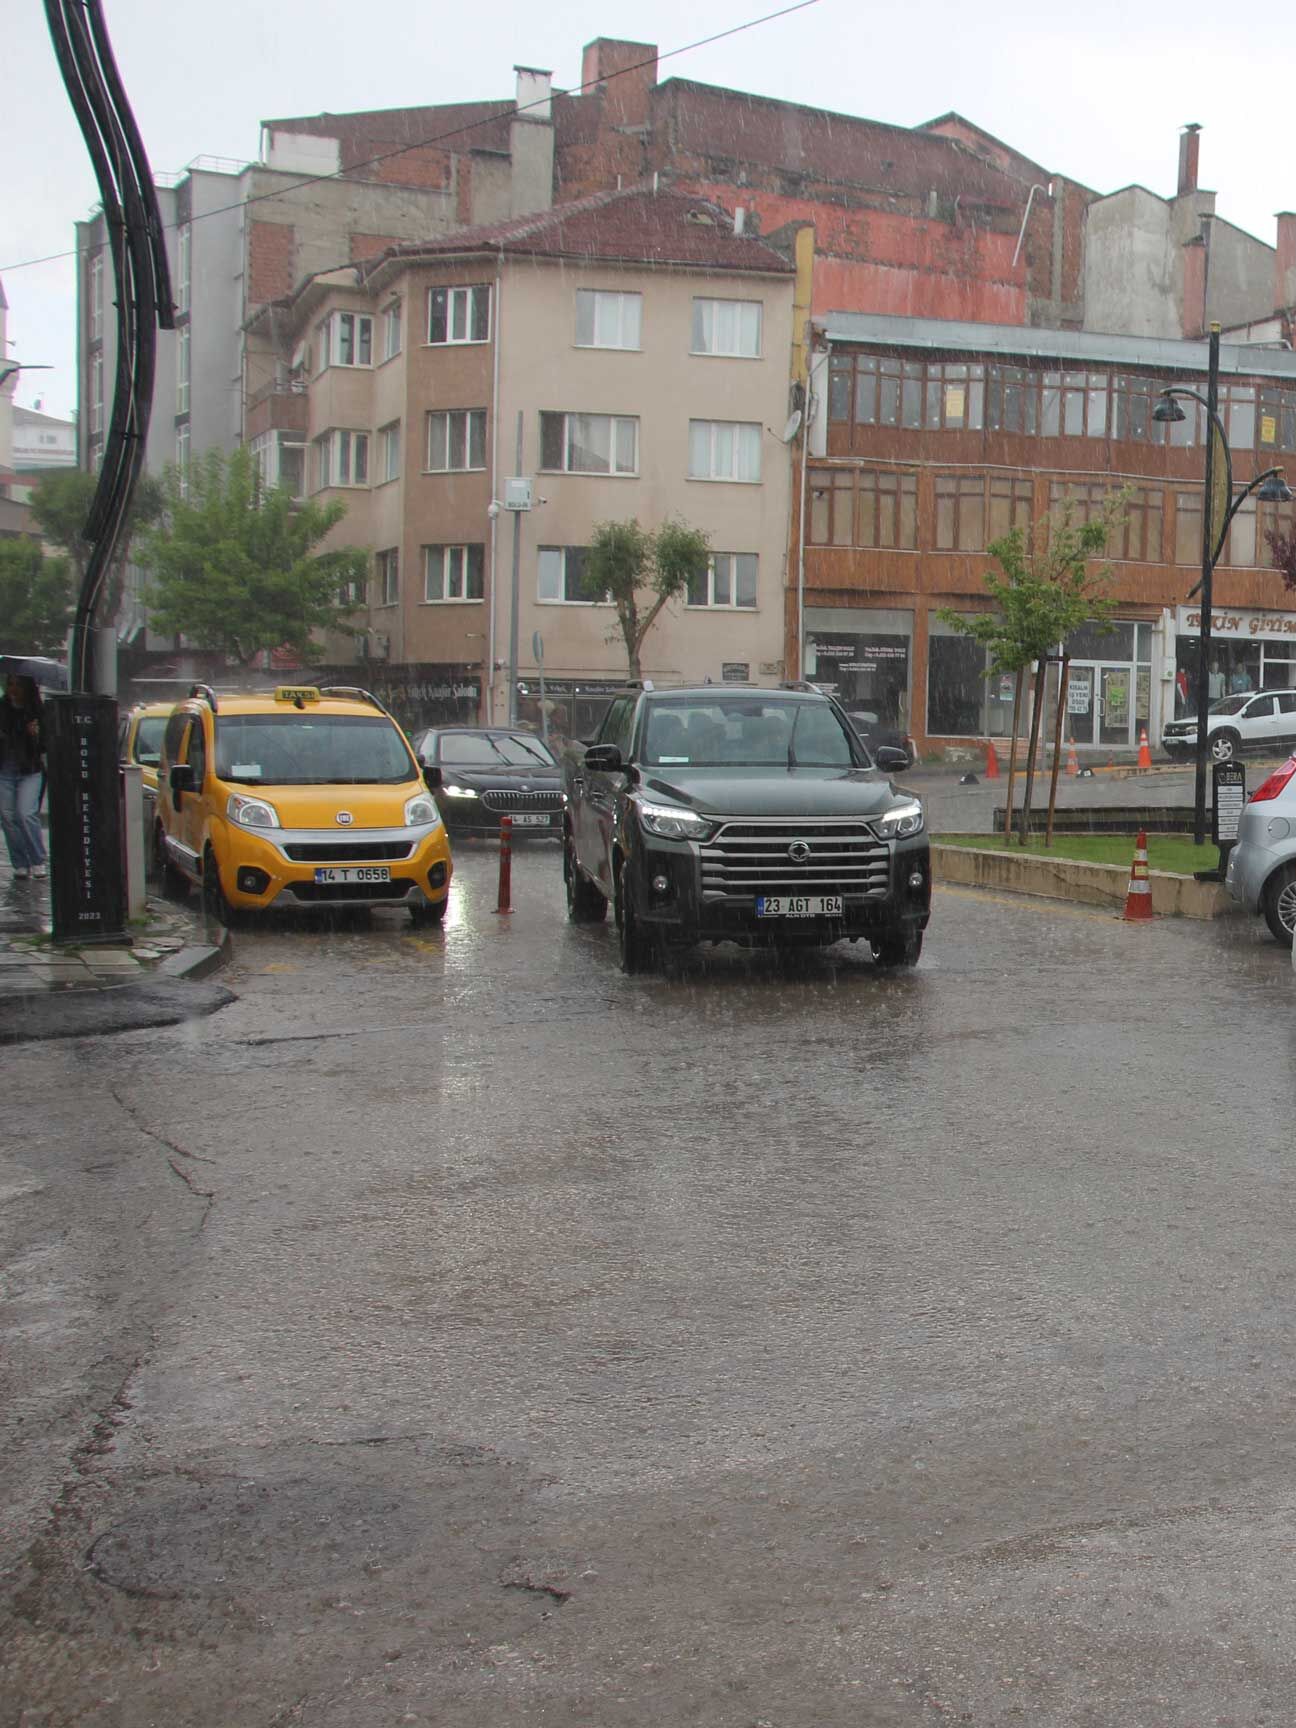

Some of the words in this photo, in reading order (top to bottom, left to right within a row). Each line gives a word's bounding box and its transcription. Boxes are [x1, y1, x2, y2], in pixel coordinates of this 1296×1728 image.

[80, 738, 88, 778] BOLU
[323, 869, 335, 881] 14
[341, 869, 350, 880] T
[357, 869, 388, 880] 0658
[765, 898, 780, 912] 23
[788, 898, 810, 912] AGT
[820, 898, 841, 912] 164
